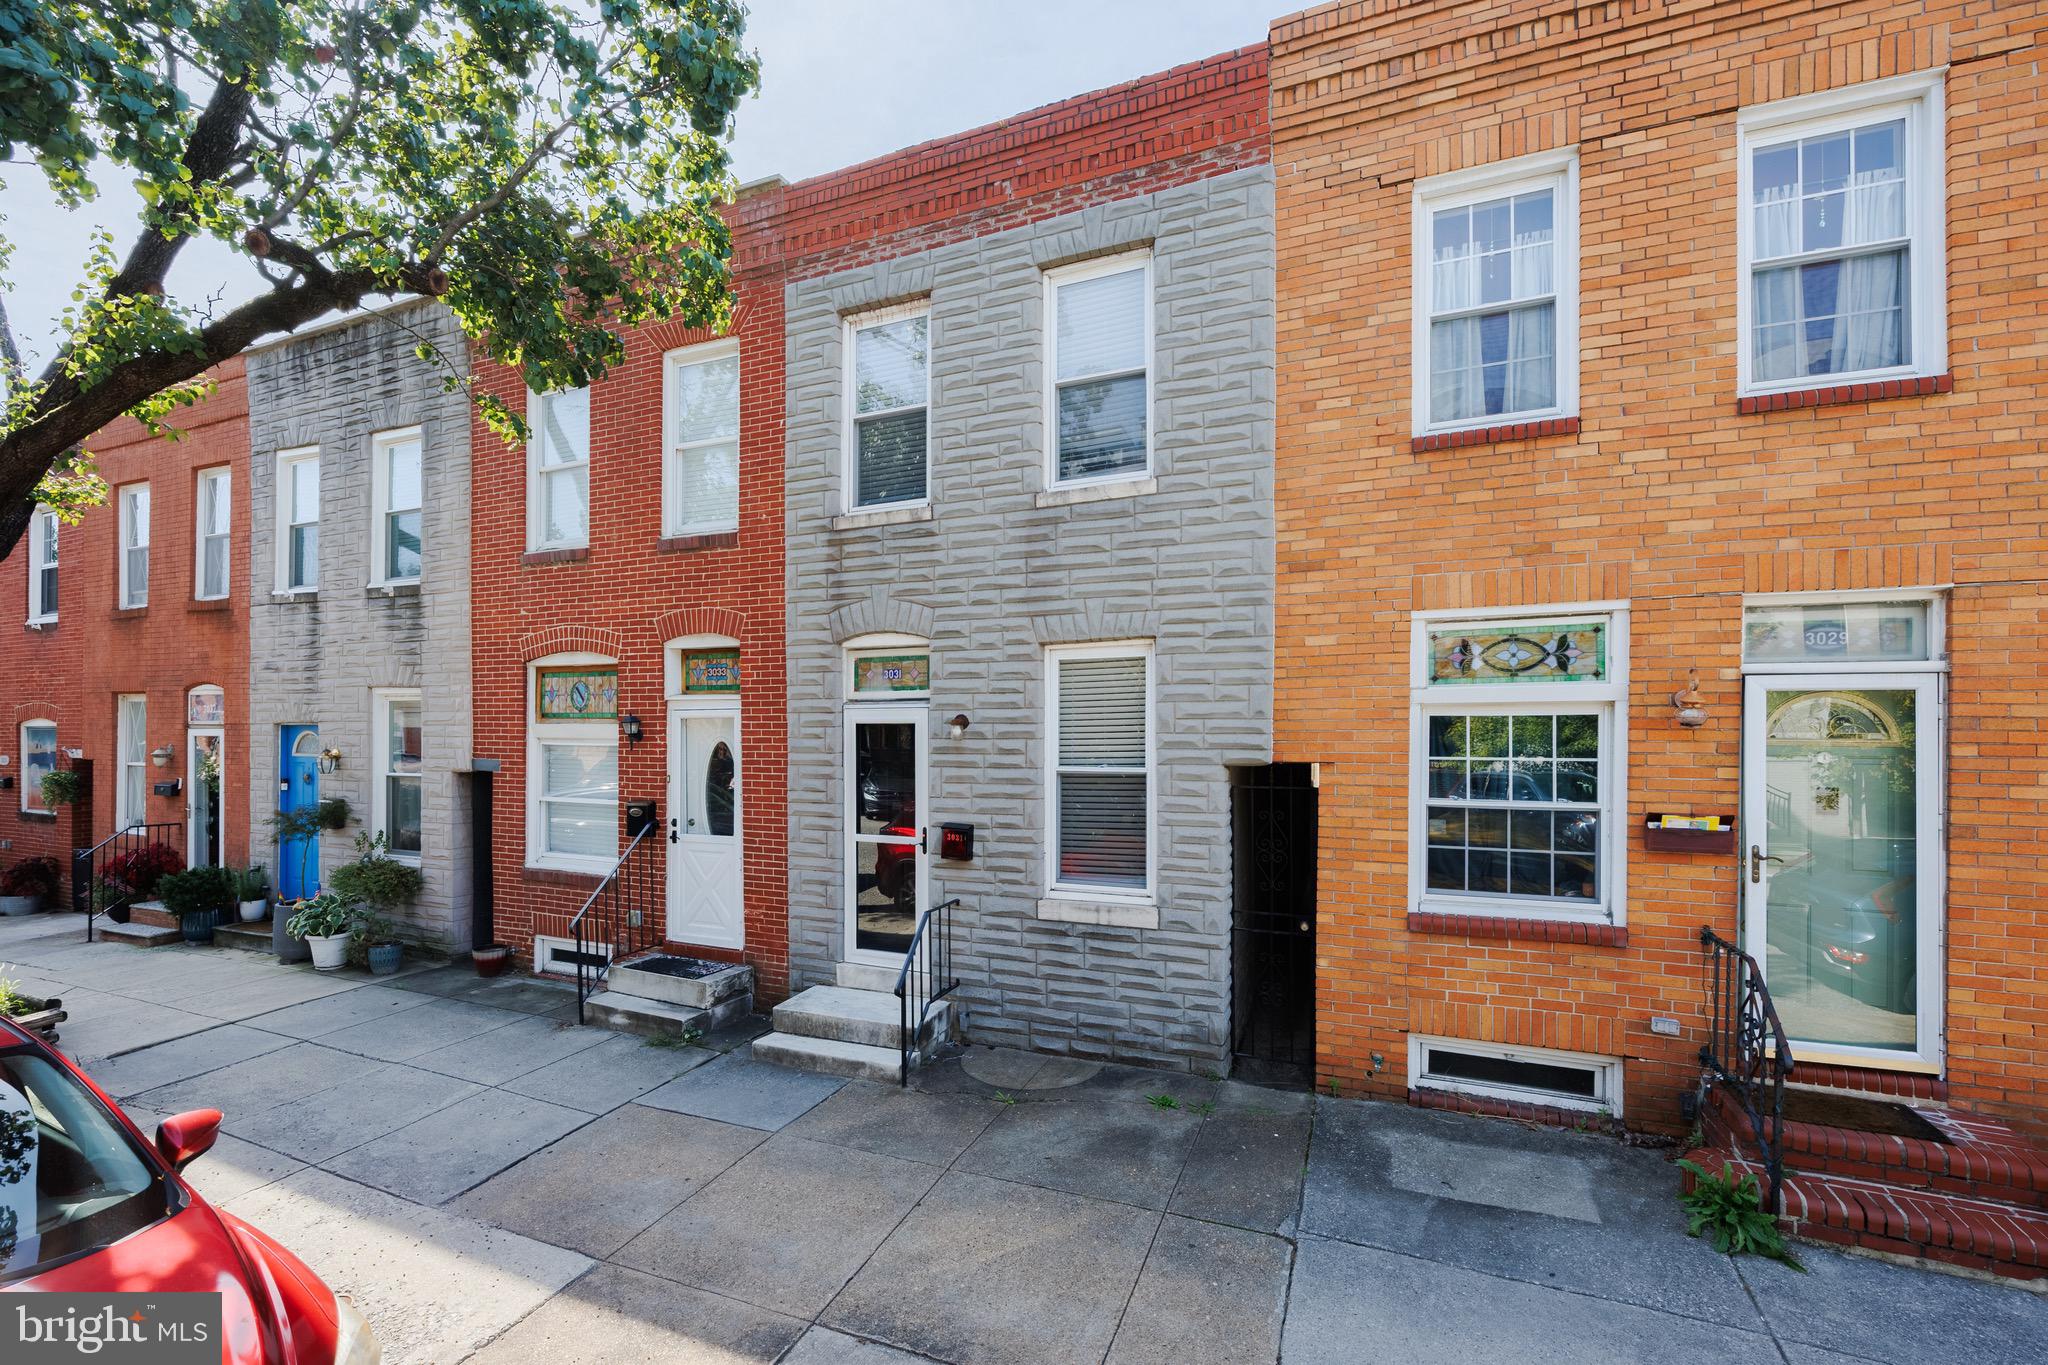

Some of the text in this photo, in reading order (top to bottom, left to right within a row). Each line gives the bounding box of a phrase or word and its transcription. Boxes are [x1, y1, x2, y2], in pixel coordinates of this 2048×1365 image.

[1805, 631, 1848, 645] 3029
[707, 667, 727, 676] 3033
[883, 669, 902, 679] 3031
